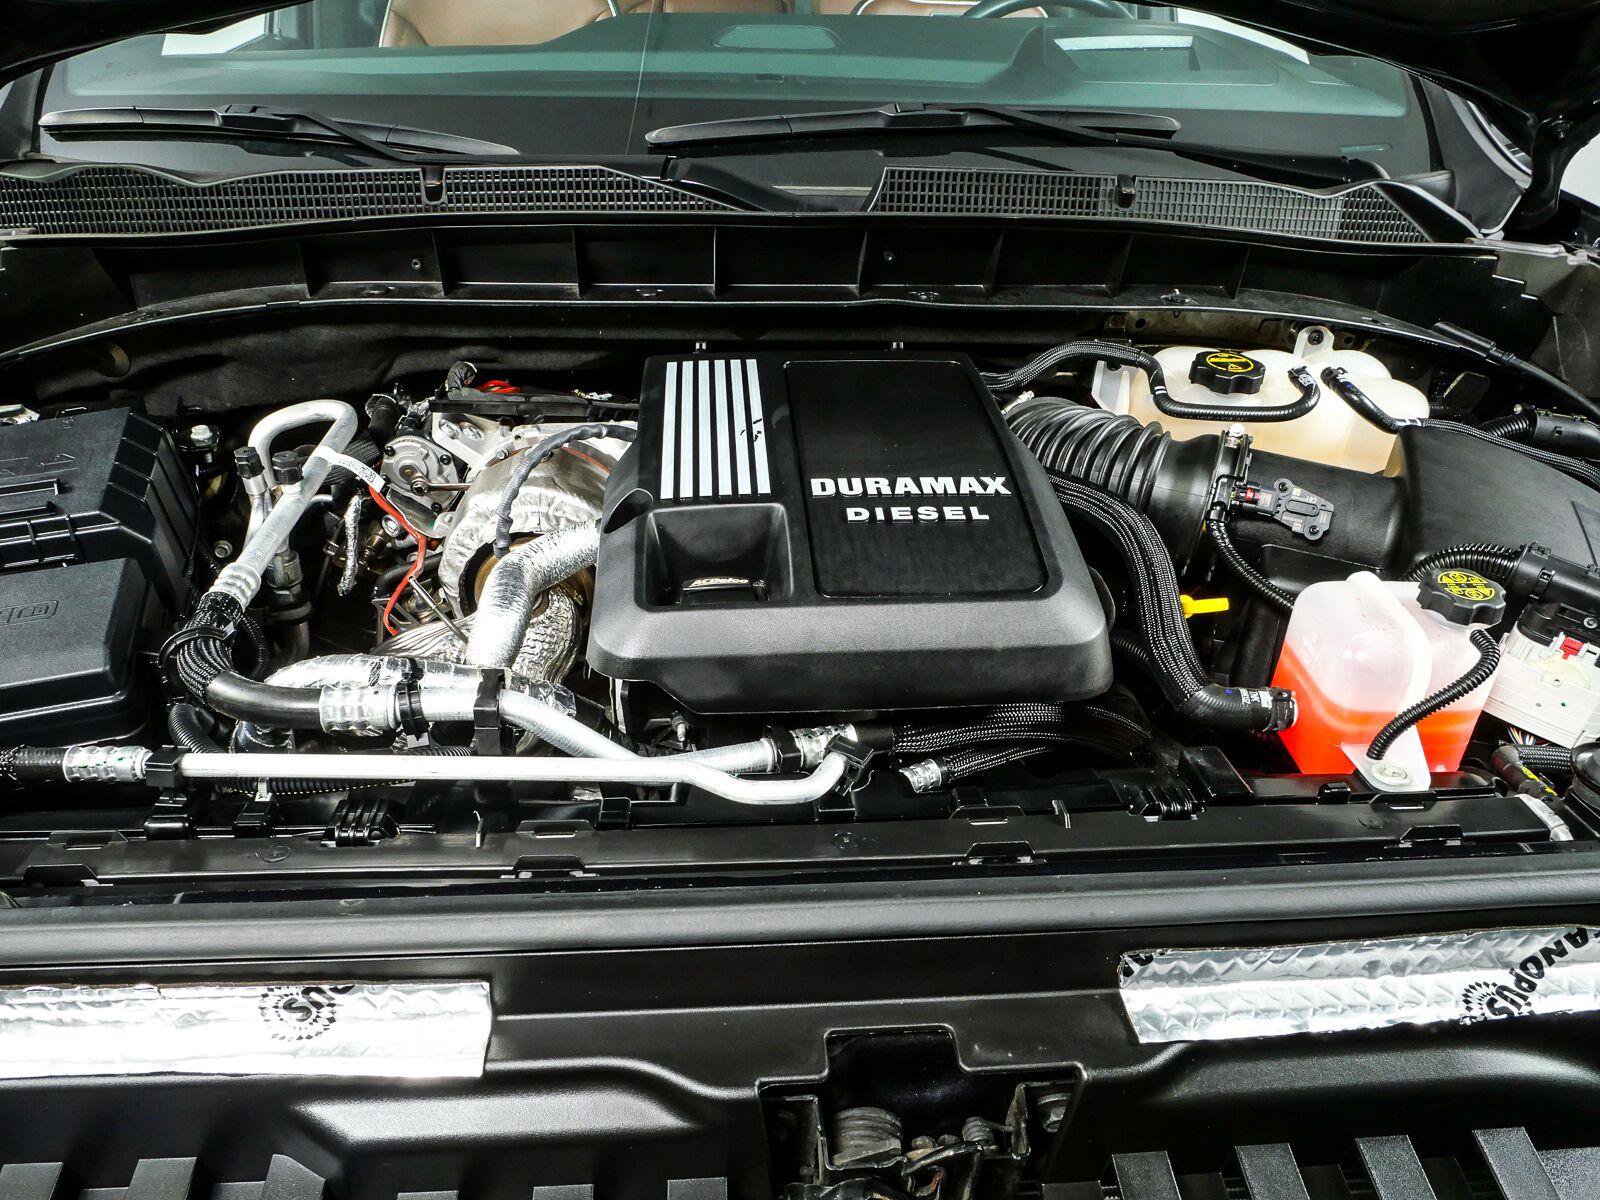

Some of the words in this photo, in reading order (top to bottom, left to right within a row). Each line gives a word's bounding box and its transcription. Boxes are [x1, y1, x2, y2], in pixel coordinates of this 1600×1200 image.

[810, 476, 1012, 497] DURAMAX
[846, 506, 990, 522] DIESEL
[1485, 927, 1600, 1018] ANOPUS
